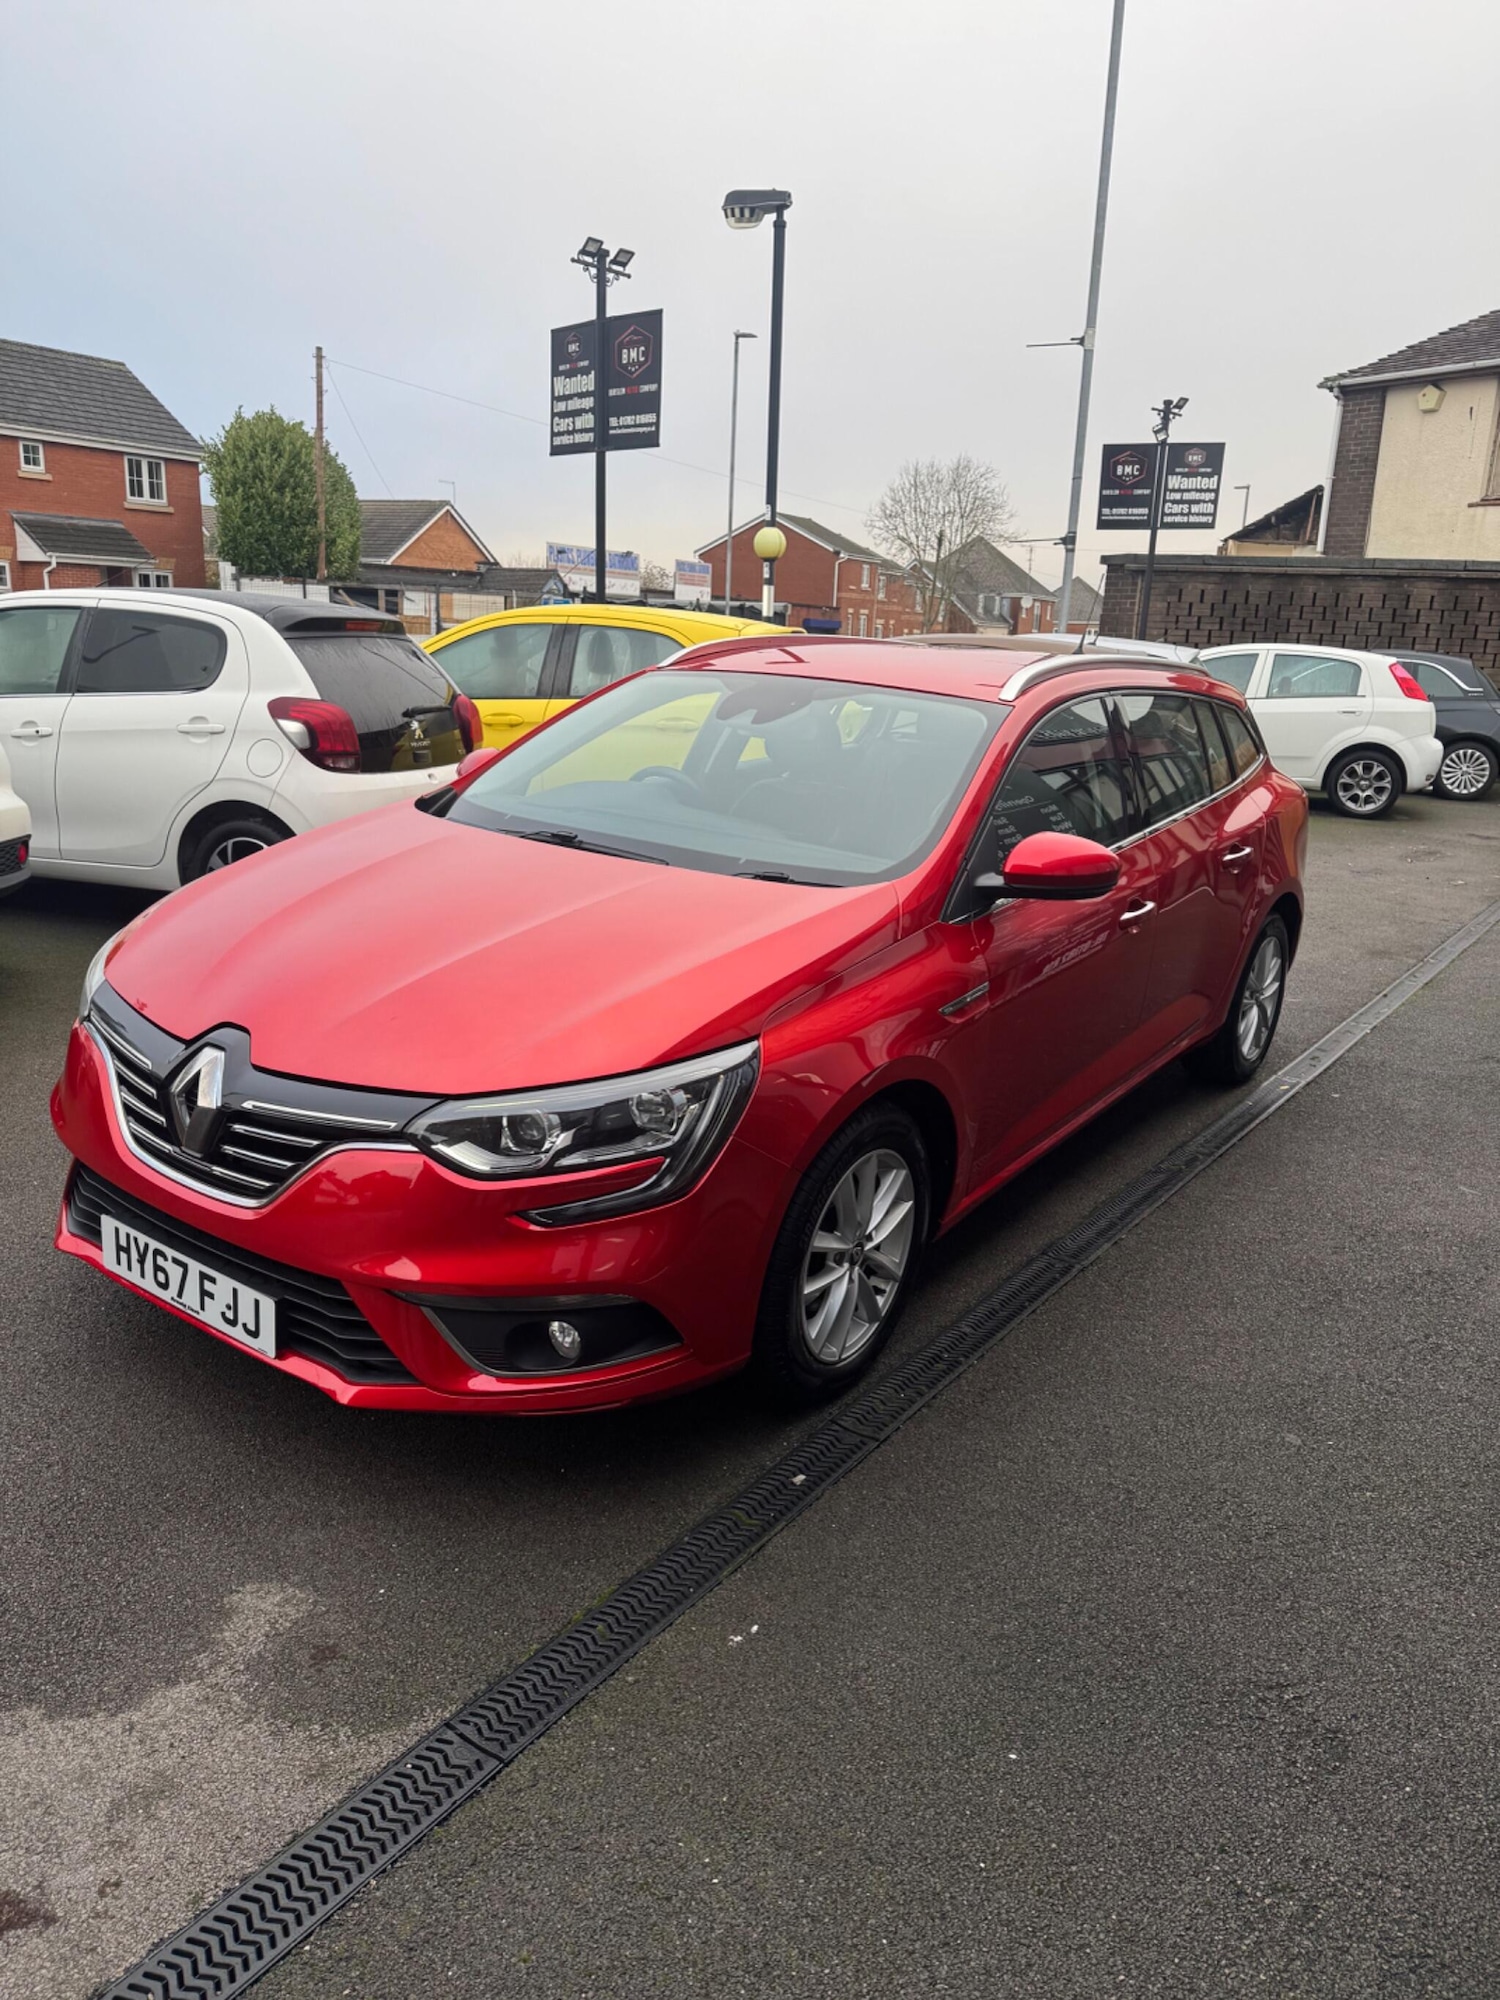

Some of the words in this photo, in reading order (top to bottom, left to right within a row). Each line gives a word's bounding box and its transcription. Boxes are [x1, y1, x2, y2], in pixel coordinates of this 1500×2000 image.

[621, 346, 646, 363] BMC
[553, 370, 595, 397] Wanted
[553, 400, 567, 412] Low
[567, 396, 595, 411] mileage
[553, 415, 574, 432] Cars
[574, 412, 595, 430] with
[552, 435, 574, 446] service
[573, 432, 595, 444] history
[1116, 464, 1140, 476] BMC
[1167, 474, 1219, 490] Wanted
[1166, 491, 1182, 500] Low
[1182, 490, 1216, 501] mileage
[1164, 502, 1189, 514] Cars
[1190, 502, 1215, 514] with
[1163, 514, 1188, 522] service
[1188, 514, 1213, 523] history
[114, 1226, 189, 1300] HY67
[198, 1269, 261, 1339] FJJ
